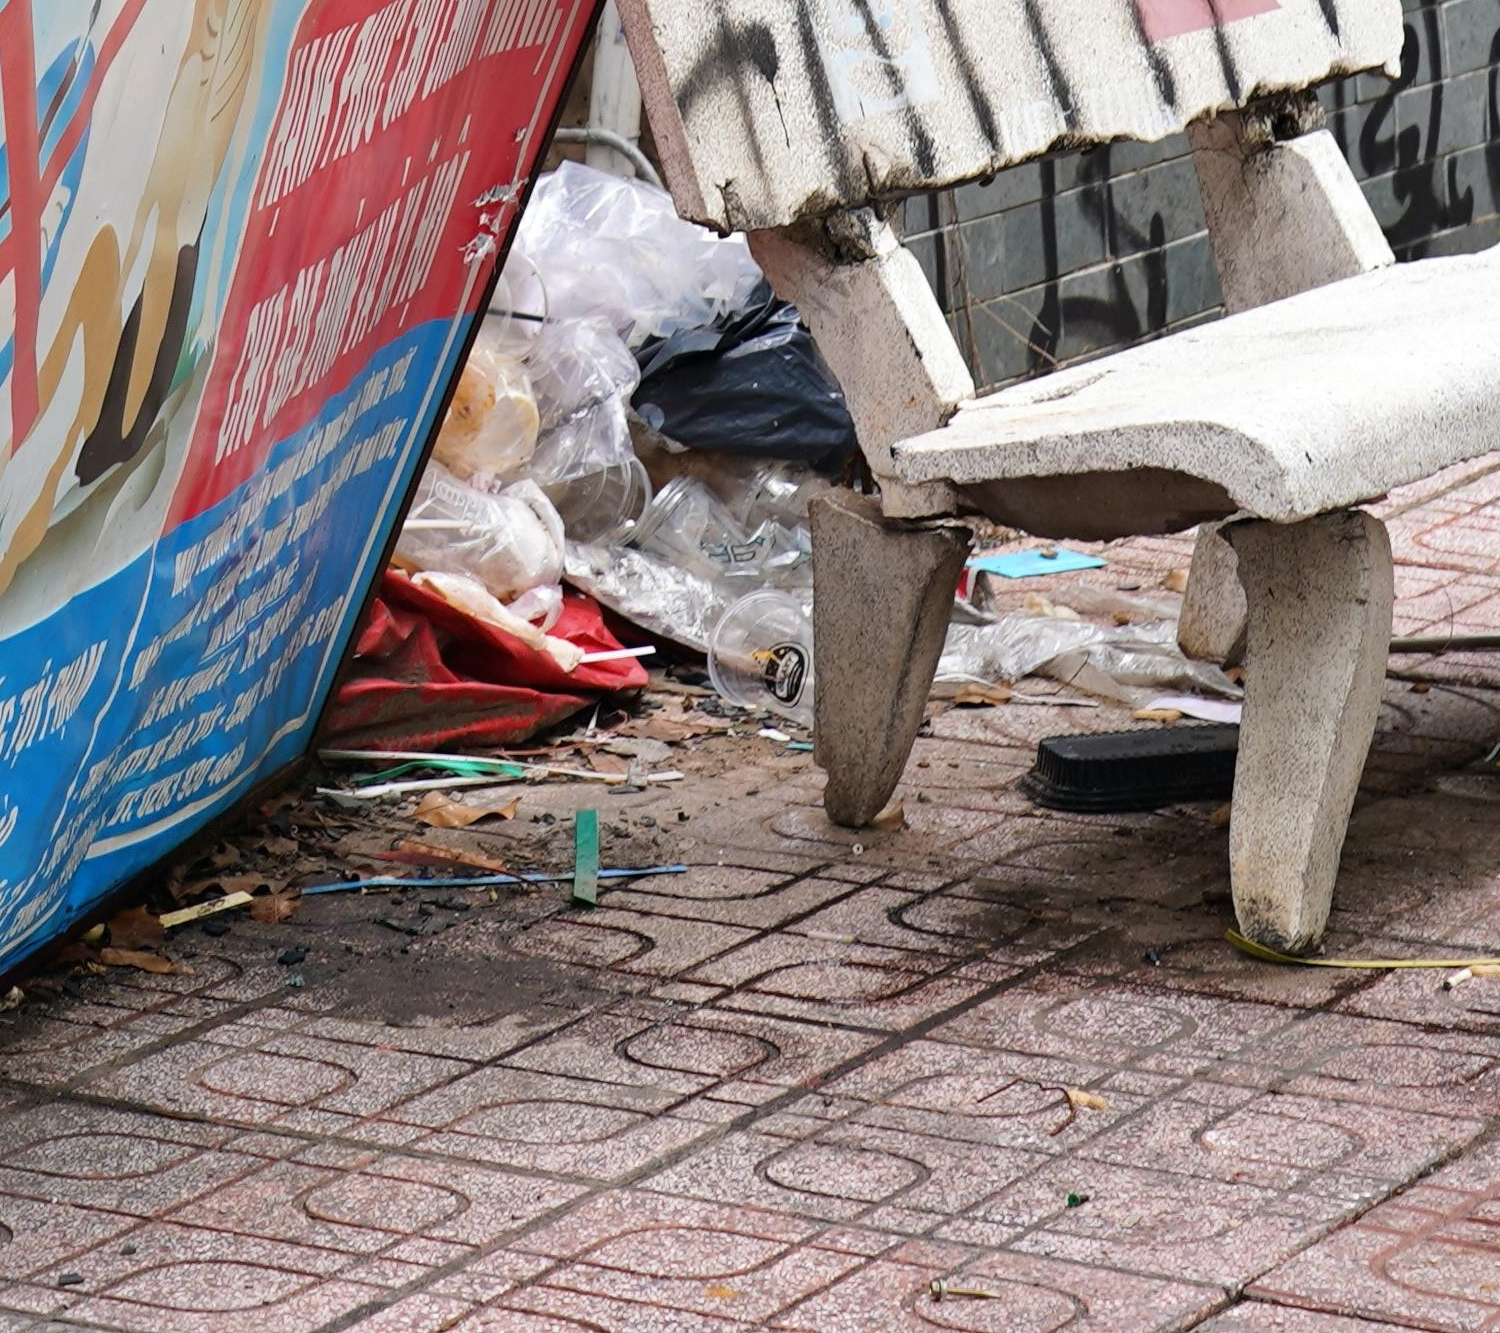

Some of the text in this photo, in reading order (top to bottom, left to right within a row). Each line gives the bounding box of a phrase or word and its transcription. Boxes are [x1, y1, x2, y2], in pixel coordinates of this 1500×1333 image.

[257, 23, 357, 235] HẠNH
[215, 115, 470, 465] CHO GIA ĐÌNH VÀ XÃ HỘI
[6, 661, 50, 757] TỘI
[40, 642, 106, 739] PHẠM
